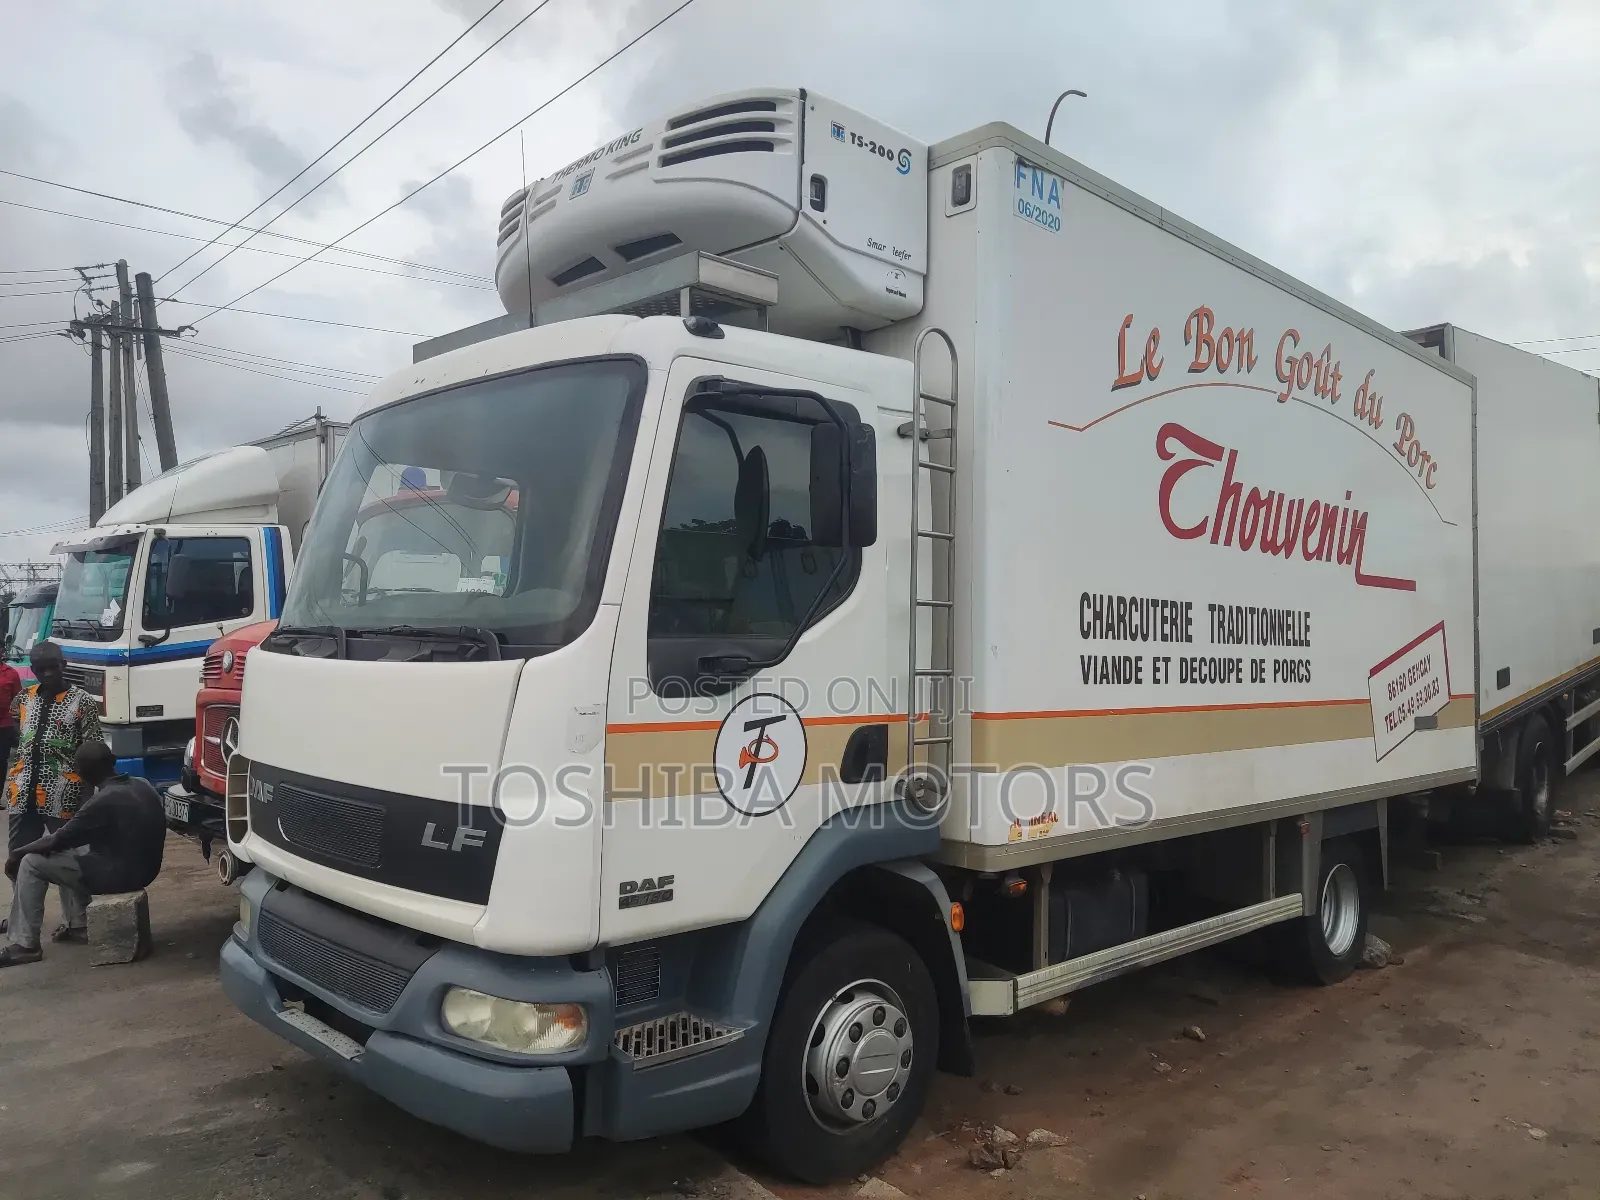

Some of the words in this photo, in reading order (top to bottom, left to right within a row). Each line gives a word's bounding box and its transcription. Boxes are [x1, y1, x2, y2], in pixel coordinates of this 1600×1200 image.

[552, 147, 605, 184] THERMO
[605, 127, 643, 156] KING
[850, 131, 895, 162] TS-200
[1016, 157, 1061, 210] FNA
[1017, 197, 1061, 232] 06/2020
[1111, 313, 1163, 392] Le
[1184, 304, 1258, 374] Bon
[1275, 328, 1343, 404] Goût
[1353, 368, 1384, 430] du
[1393, 412, 1438, 490] Porc
[1156, 422, 1416, 591] Thouvenin
[1079, 591, 1193, 643] CHARCUTERIE
[1208, 603, 1311, 647] TRADITIONNELLE
[84, 674, 103, 687] DAF
[1080, 654, 1143, 685] VIANDE
[1152, 656, 1171, 685] ET
[1179, 656, 1243, 684] DECOUPE
[1250, 658, 1266, 683] DE
[1273, 658, 1312, 684] PORCS
[421, 822, 487, 852] LF
[619, 874, 675, 896] DAF
